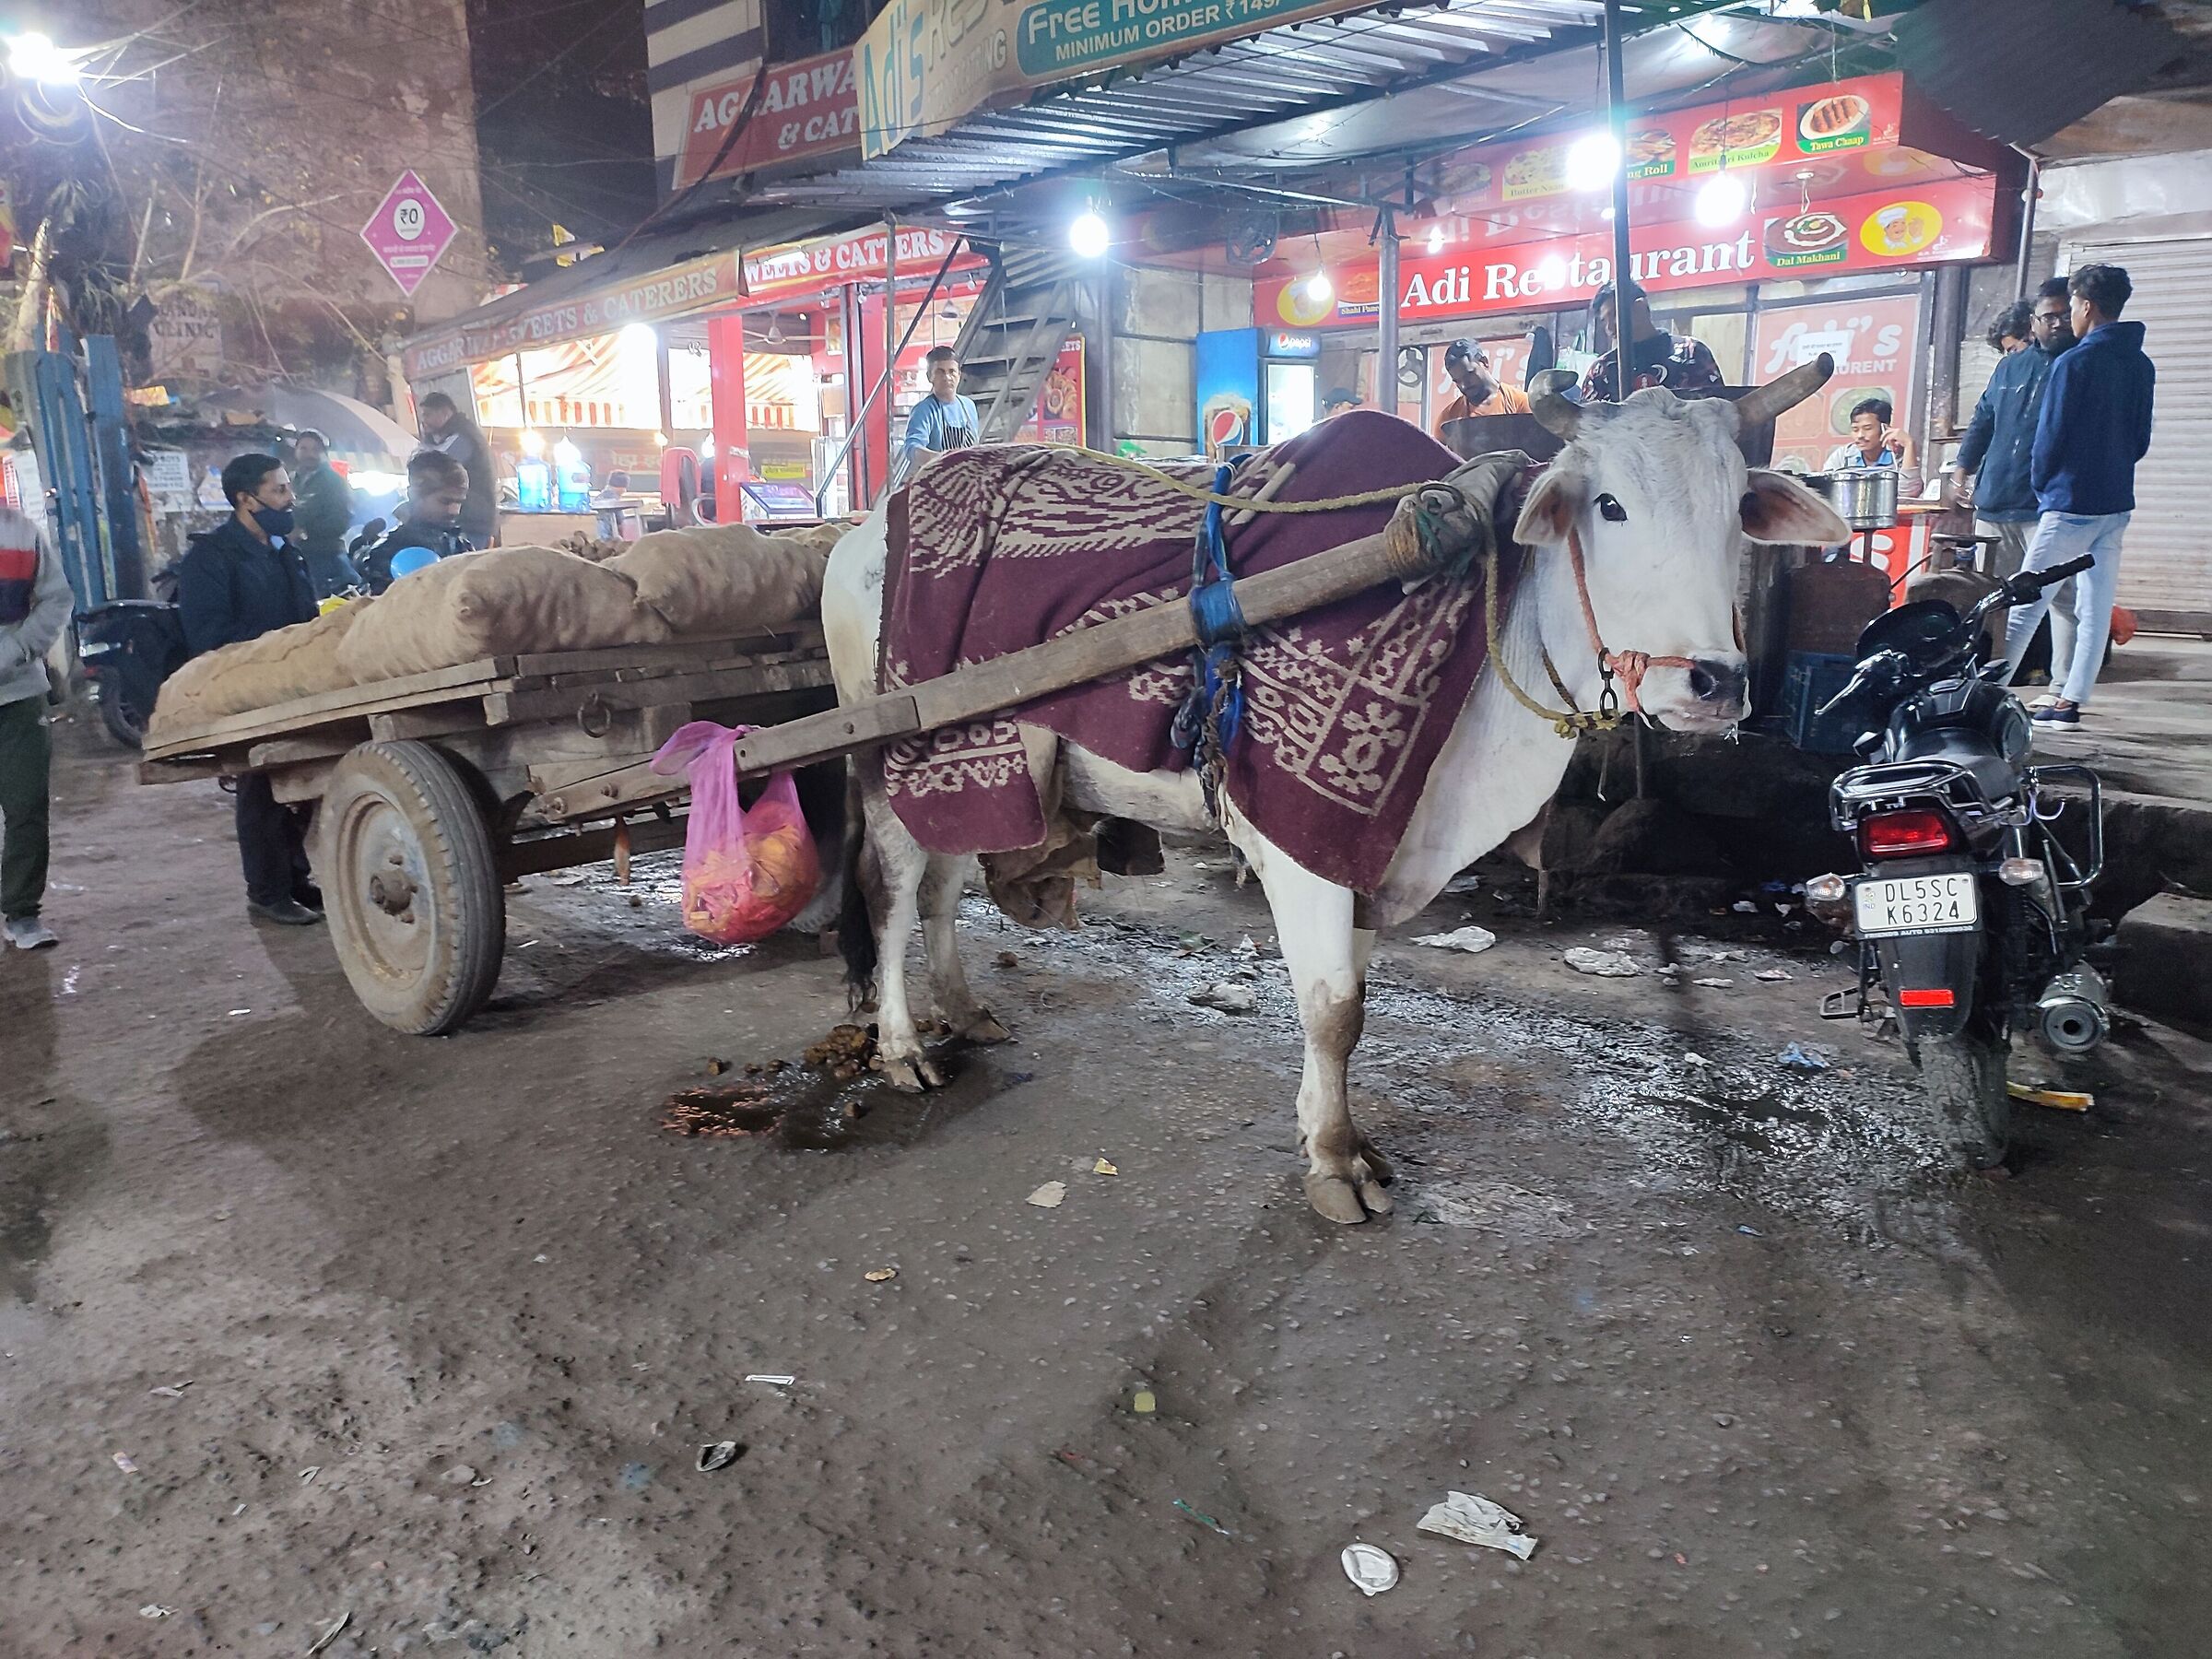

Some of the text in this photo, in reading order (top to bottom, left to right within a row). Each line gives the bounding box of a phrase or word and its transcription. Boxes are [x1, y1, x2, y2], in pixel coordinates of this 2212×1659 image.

[1055, 24, 1139, 62] MINIMUM
[1146, 5, 1220, 39] ORDER
[694, 57, 857, 133] AGARWA
[778, 123, 800, 150] &
[1810, 140, 1833, 151] Tawa
[1737, 151, 1770, 162] Kulcha
[1644, 163, 1667, 176] Roll
[814, 247, 831, 272] &
[1400, 230, 1755, 308] Adi Retarant
[1777, 252, 1841, 267] Dal Makhani
[583, 303, 598, 326] &
[604, 267, 717, 319] CATERERS
[1289, 336, 1312, 349] pepsi
[1885, 877, 1958, 902] DL5SC
[1887, 900, 1959, 924] K6324
